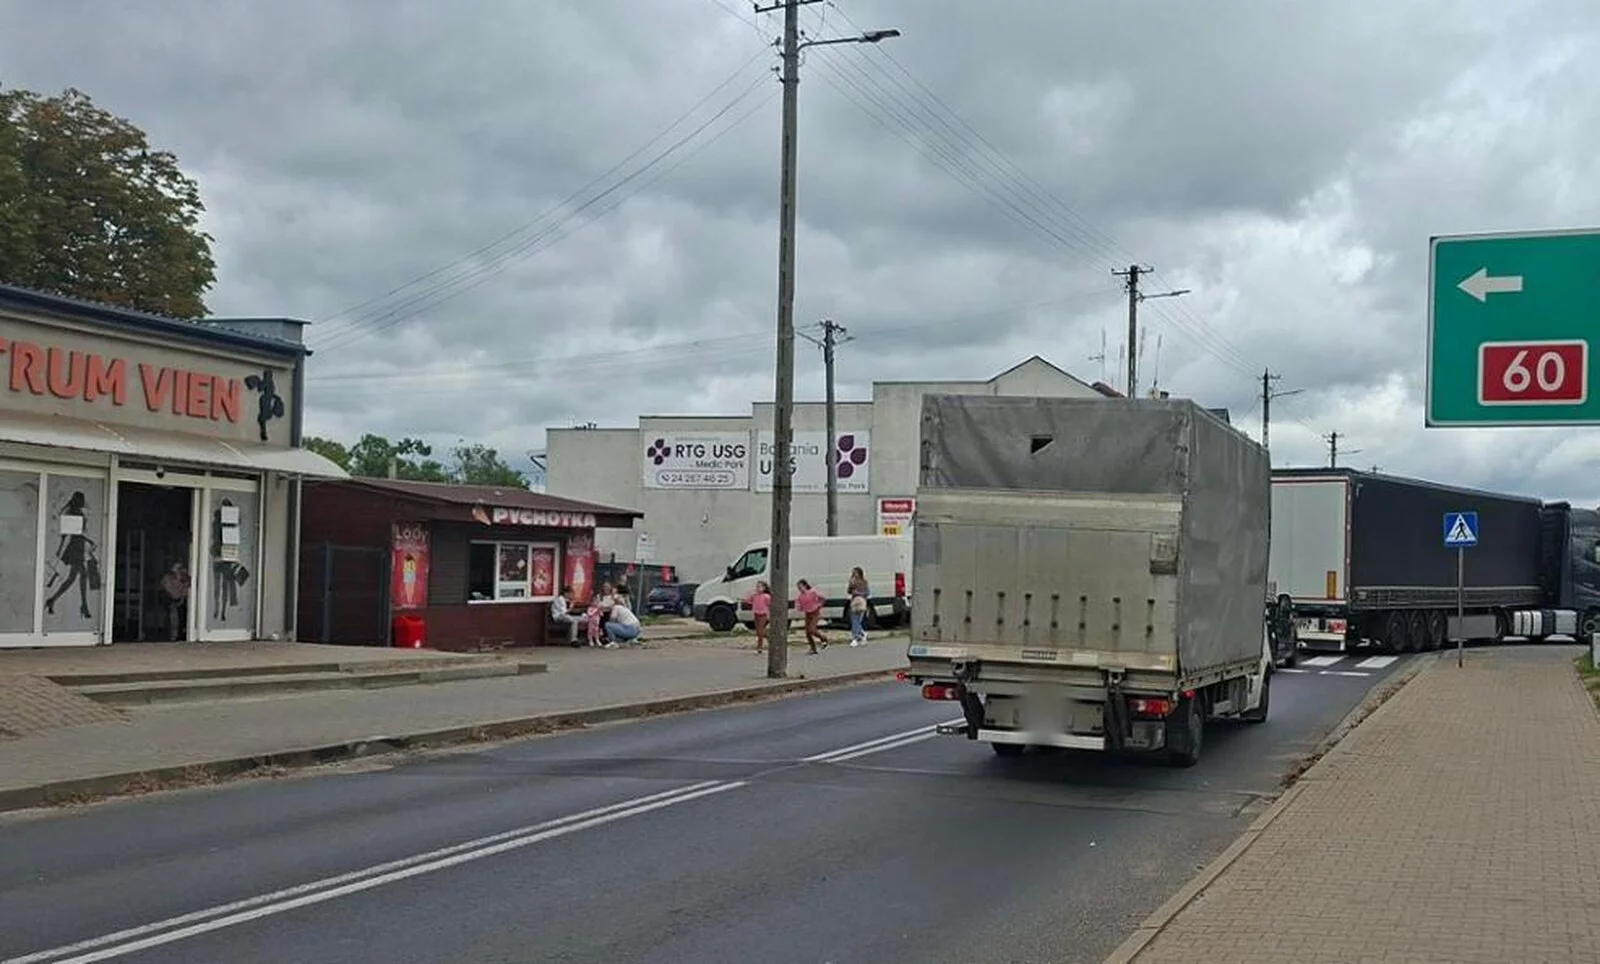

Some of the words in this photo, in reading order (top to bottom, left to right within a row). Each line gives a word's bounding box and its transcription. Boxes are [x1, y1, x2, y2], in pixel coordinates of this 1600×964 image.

[1503, 350, 1565, 393] 60
[138, 361, 241, 424] VIEN
[675, 444, 705, 459] RTG
[713, 444, 746, 459] USG
[695, 460, 723, 469] Medic
[724, 460, 744, 469] Park
[492, 507, 596, 527] PYCHOTKA
